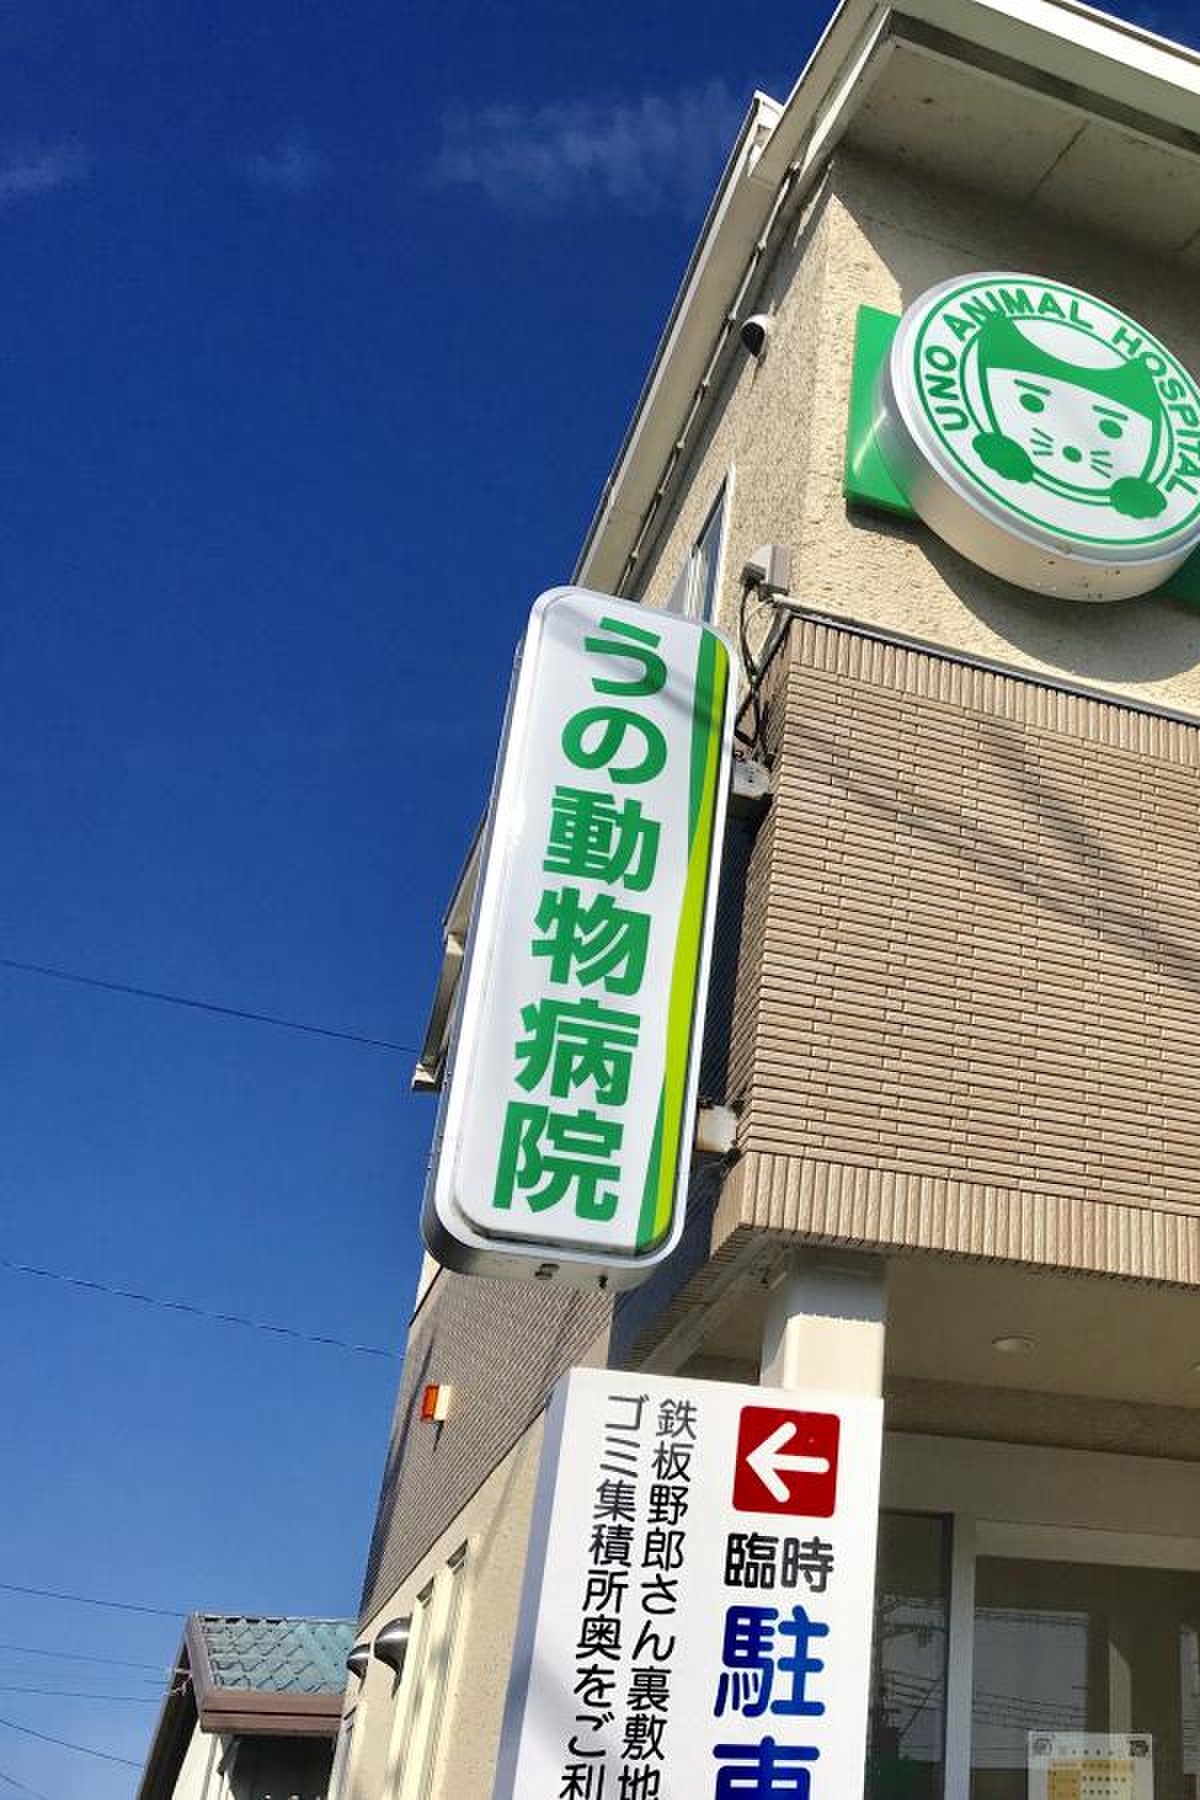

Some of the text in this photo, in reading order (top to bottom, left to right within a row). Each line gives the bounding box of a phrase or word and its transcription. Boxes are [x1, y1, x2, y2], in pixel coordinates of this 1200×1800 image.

[923, 345, 969, 433] UNO
[942, 287, 1095, 342] ANIMAL
[493, 616, 669, 1222] うの動物病院
[559, 1394, 650, 1800] ゴミ集積所奥をご利
[617, 1397, 699, 1800] 鉄板野郎さん裏敷地
[723, 1531, 835, 1593] 臨時
